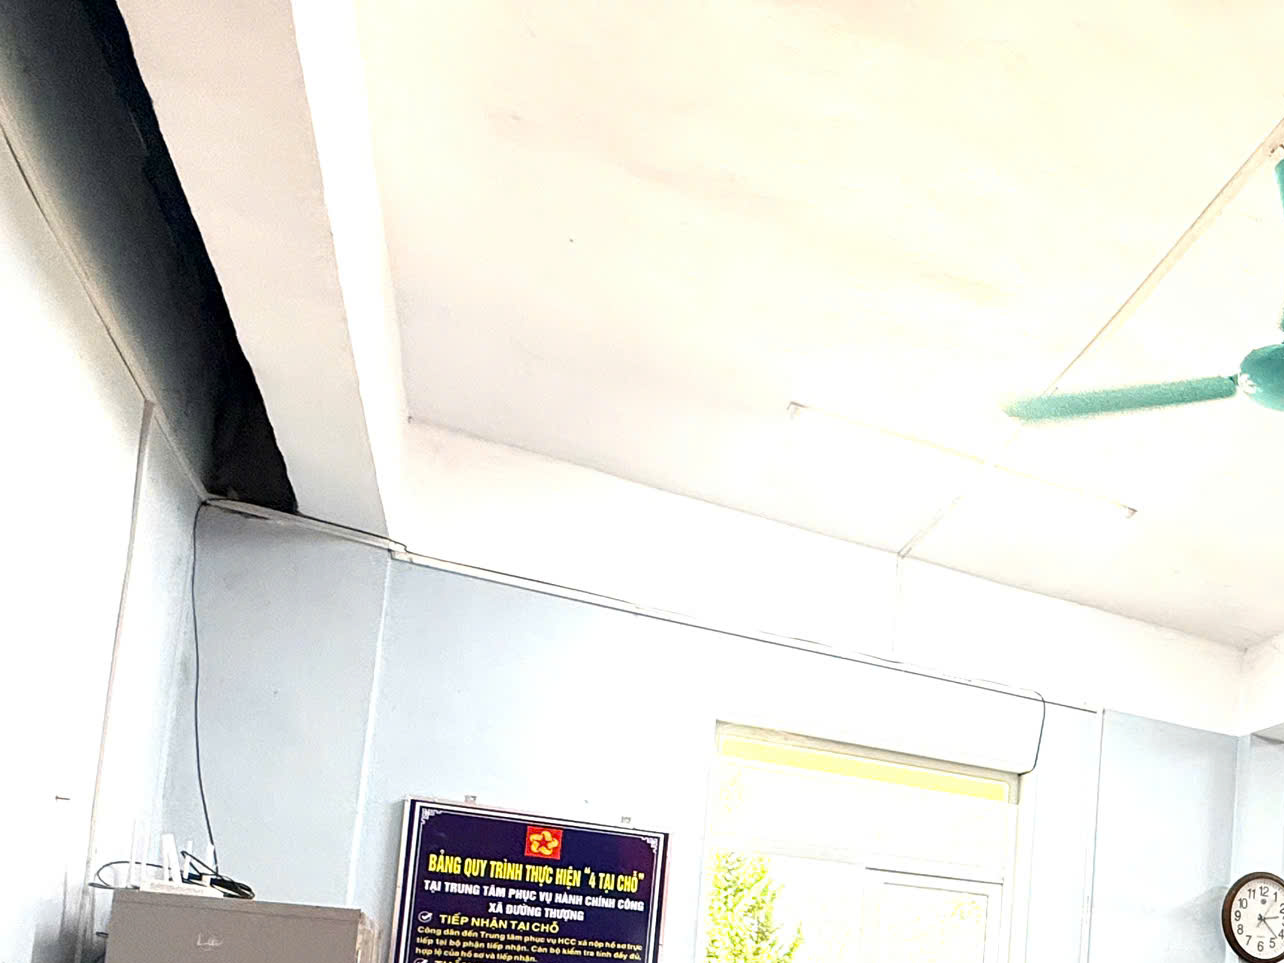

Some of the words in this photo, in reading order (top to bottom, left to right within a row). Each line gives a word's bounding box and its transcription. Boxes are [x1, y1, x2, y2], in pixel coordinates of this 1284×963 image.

[428, 847, 461, 874] BẢNG
[463, 857, 486, 879] QUY
[489, 856, 523, 881] TRÌNH
[524, 863, 553, 887] THỰC
[555, 864, 581, 890] HIỆN
[597, 872, 614, 893] TẠI
[423, 879, 441, 894] TẠI
[443, 881, 480, 895] TRUNG
[482, 883, 505, 897] TÂM
[508, 888, 536, 903] PHỤC
[538, 890, 552, 904] VỤ
[554, 891, 582, 905] HÀNH
[584, 893, 615, 908] CHÍNH
[617, 897, 644, 911] CÔNG
[1248, 889, 1256, 899] 11
[1260, 885, 1269, 897] 12
[1273, 892, 1278, 902] 1
[1238, 898, 1248, 909] 10
[488, 900, 503, 913] XÃ
[505, 901, 541, 917] ĐƯỜNG
[543, 906, 584, 923] THƯỢNG
[1234, 910, 1241, 921] 9
[439, 910, 469, 926] TIẾP
[470, 915, 507, 930] NHẬN
[509, 920, 529, 932] TẠI
[531, 918, 559, 933] CHỖ
[1237, 924, 1244, 935] 8
[1278, 929, 1284, 940] 4
[1246, 935, 1252, 945] 7
[1269, 938, 1275, 948] 5
[1258, 941, 1264, 952] 6
